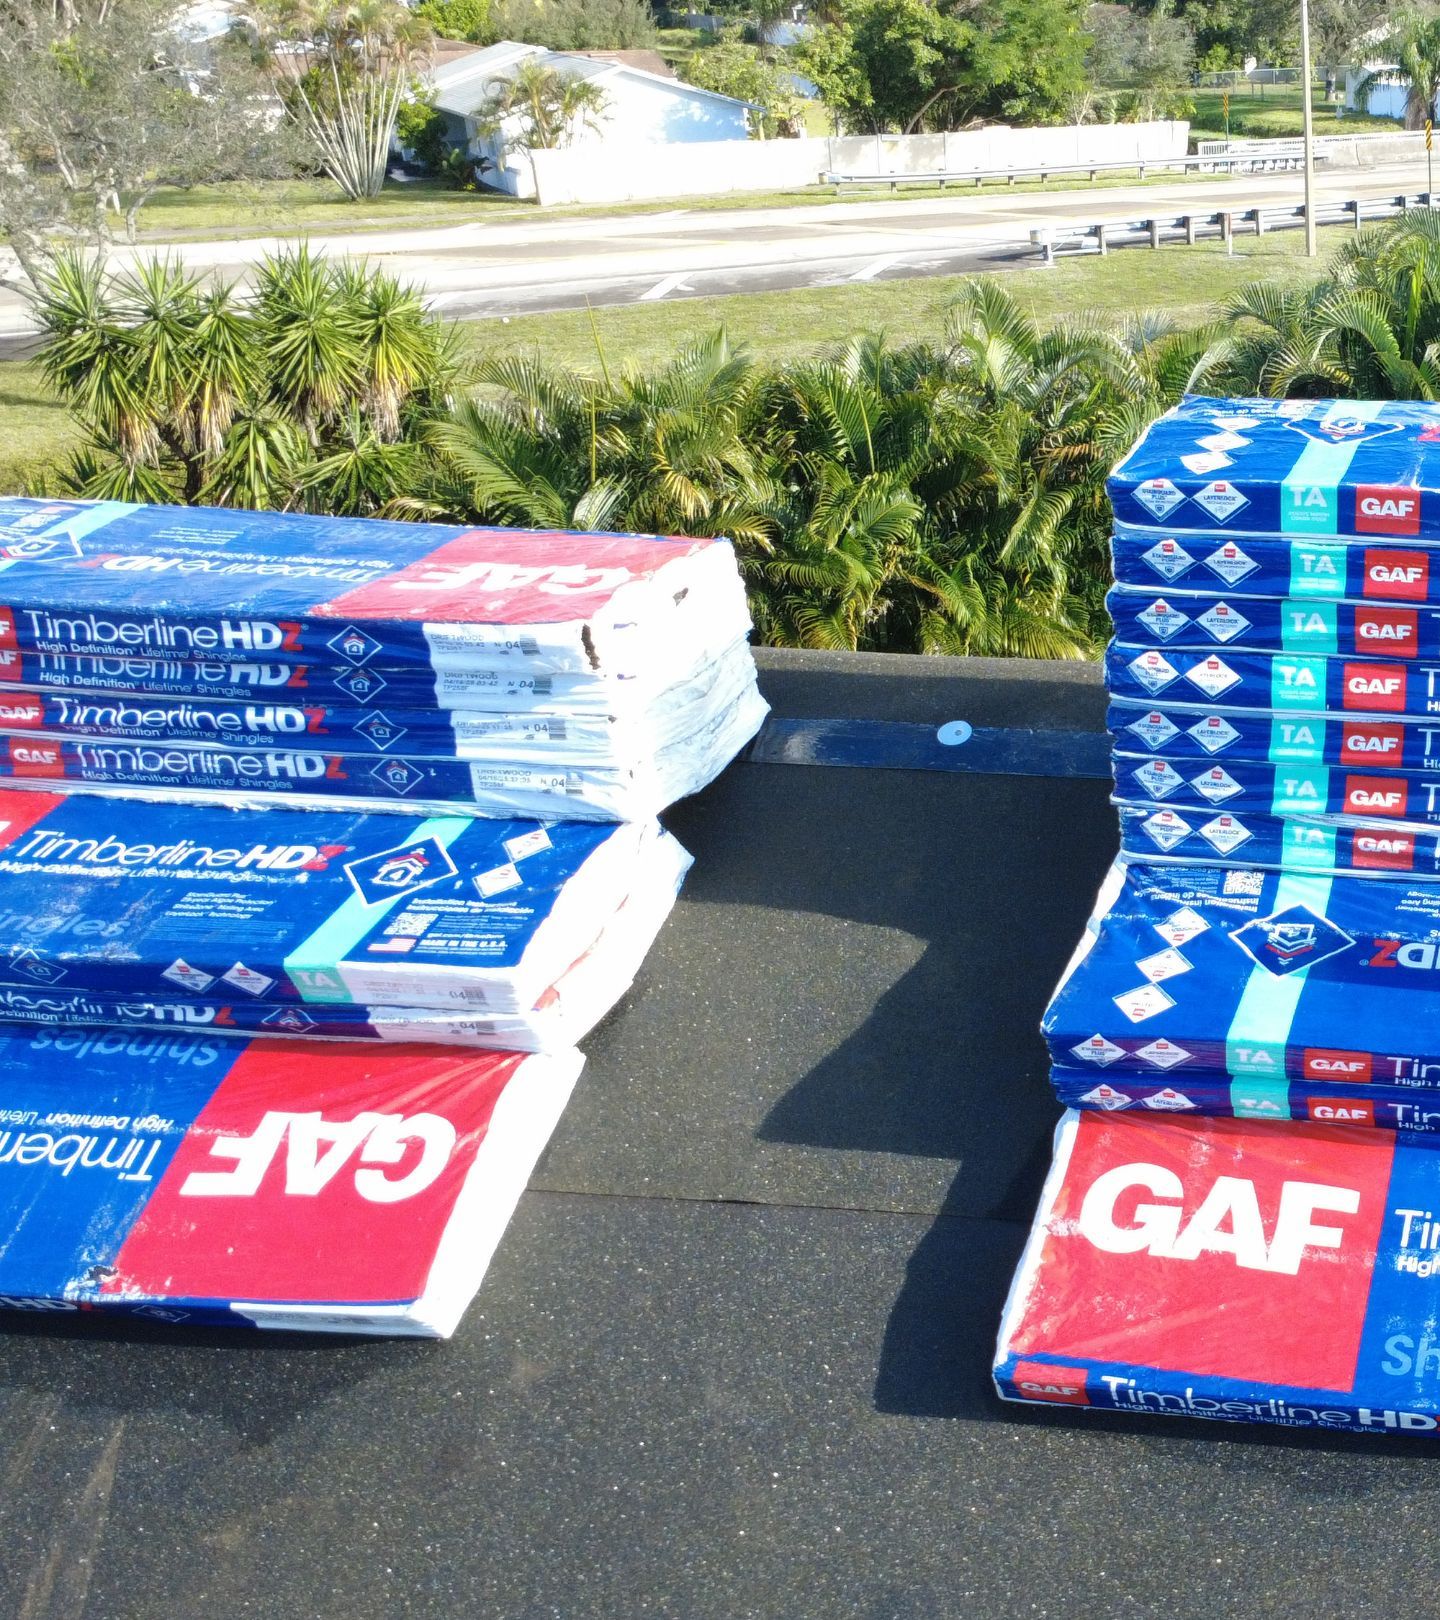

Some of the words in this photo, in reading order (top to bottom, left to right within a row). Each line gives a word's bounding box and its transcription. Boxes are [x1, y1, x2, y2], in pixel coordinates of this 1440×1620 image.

[1289, 486, 1327, 508] TA
[1361, 497, 1414, 517] GAF
[1301, 554, 1337, 575] TA
[390, 561, 632, 595] GAF
[1370, 565, 1423, 584] GAF
[22, 609, 219, 648] Timberline
[1290, 612, 1328, 634] TA
[1359, 622, 1412, 641] GAF
[36, 640, 68, 653] High
[505, 639, 520, 651] 04
[40, 672, 71, 687] High
[196, 684, 252, 698] Shingles
[519, 680, 534, 690] 04
[1279, 666, 1316, 687] TA
[1348, 677, 1401, 695] GAF
[51, 696, 242, 732] Timberline
[534, 723, 548, 733] 04
[1280, 724, 1315, 745] TA
[221, 731, 275, 746] Shingles
[1348, 735, 1399, 753] GAF
[12, 748, 58, 765] GAF
[72, 742, 263, 777] Timberline
[81, 770, 115, 783] High
[238, 776, 293, 791] Shingles
[551, 777, 565, 788] 04
[1283, 779, 1318, 798] TA
[1350, 790, 1401, 807] GAF
[1293, 826, 1325, 844] TA
[16, 829, 243, 867] Timberline
[1358, 837, 1409, 854] GAF
[297, 970, 340, 988] TA
[30, 1028, 228, 1067] Shingles
[1235, 1048, 1274, 1065] TA
[1309, 1057, 1365, 1074] GAF
[1395, 1077, 1432, 1088] High
[1313, 1106, 1368, 1121] GAF
[132, 1114, 173, 1132] High
[179, 1110, 457, 1203] GAF
[1079, 1162, 1361, 1276] GAF
[1020, 1381, 1079, 1397] GAF
[1100, 1374, 1350, 1423] Timberline
[1113, 1400, 1155, 1414] High
